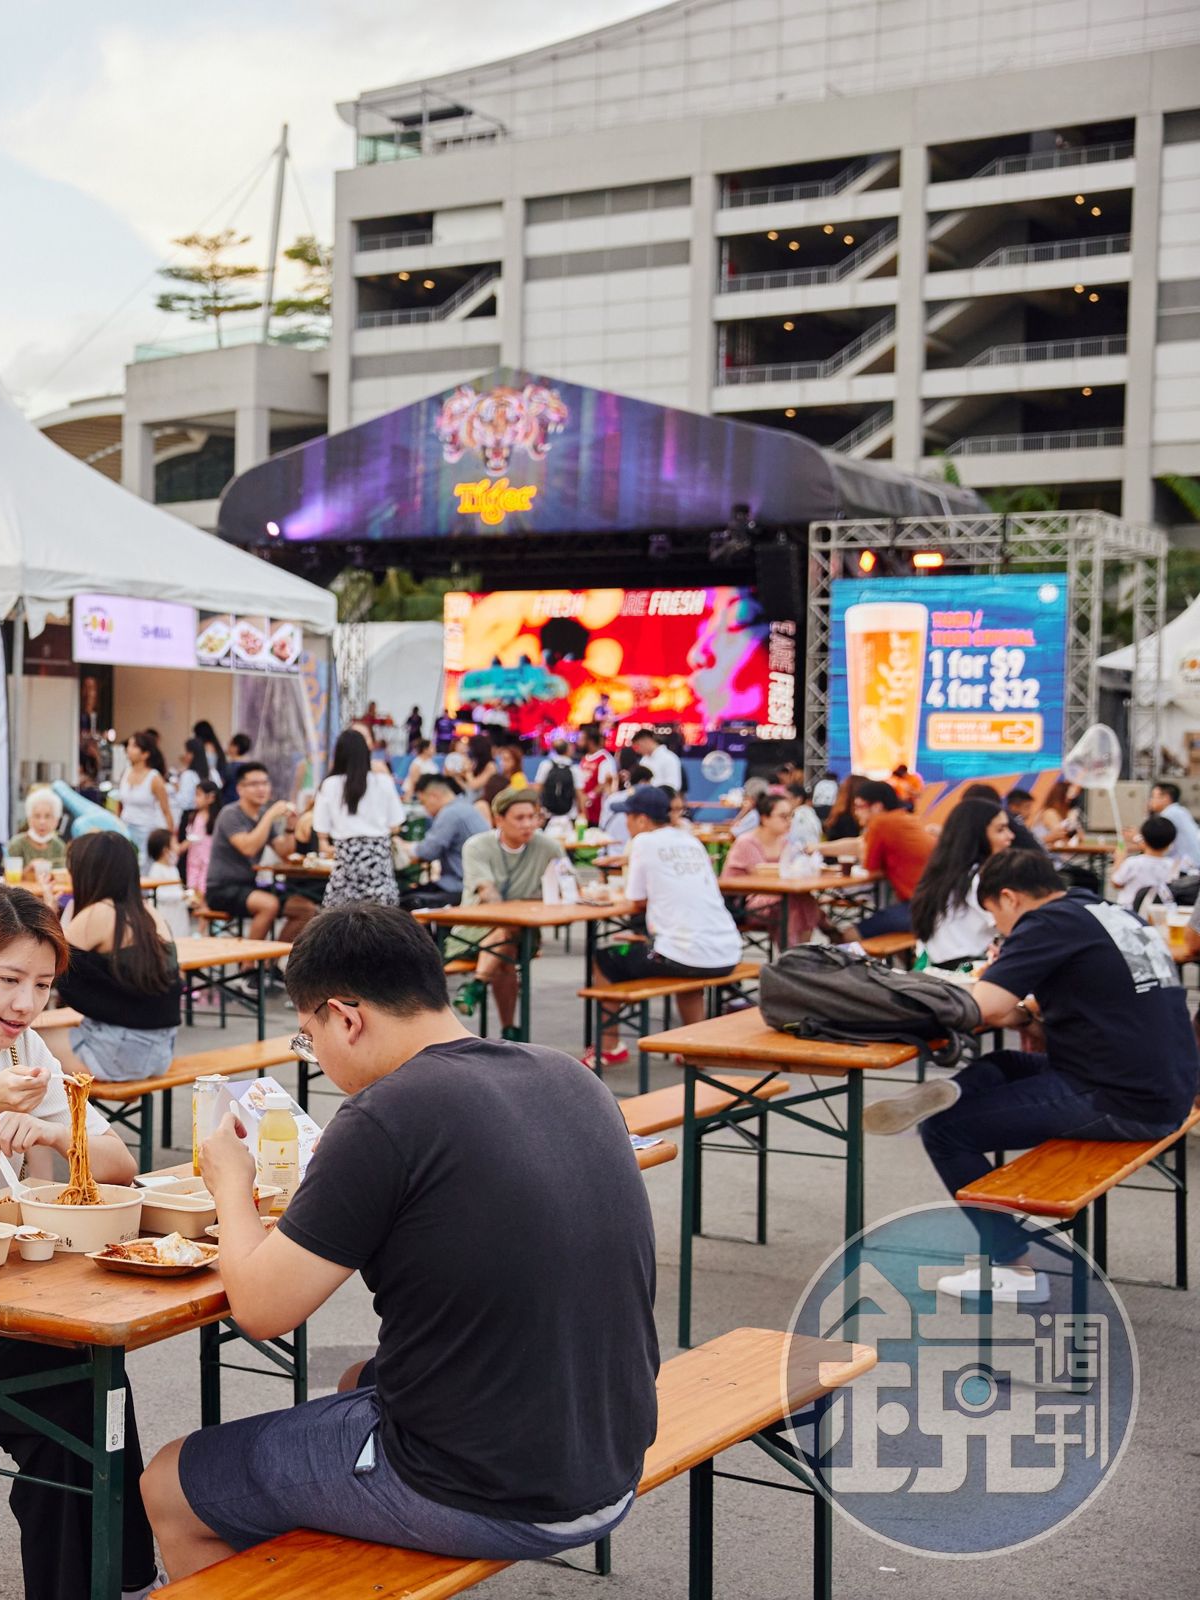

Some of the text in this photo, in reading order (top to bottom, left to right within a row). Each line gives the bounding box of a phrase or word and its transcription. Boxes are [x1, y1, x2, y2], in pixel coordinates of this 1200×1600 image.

[453, 477, 538, 525] Tiger
[648, 590, 707, 616] FRESH
[928, 646, 1026, 680] 1 for $9
[925, 678, 1041, 712] 4 for $32
